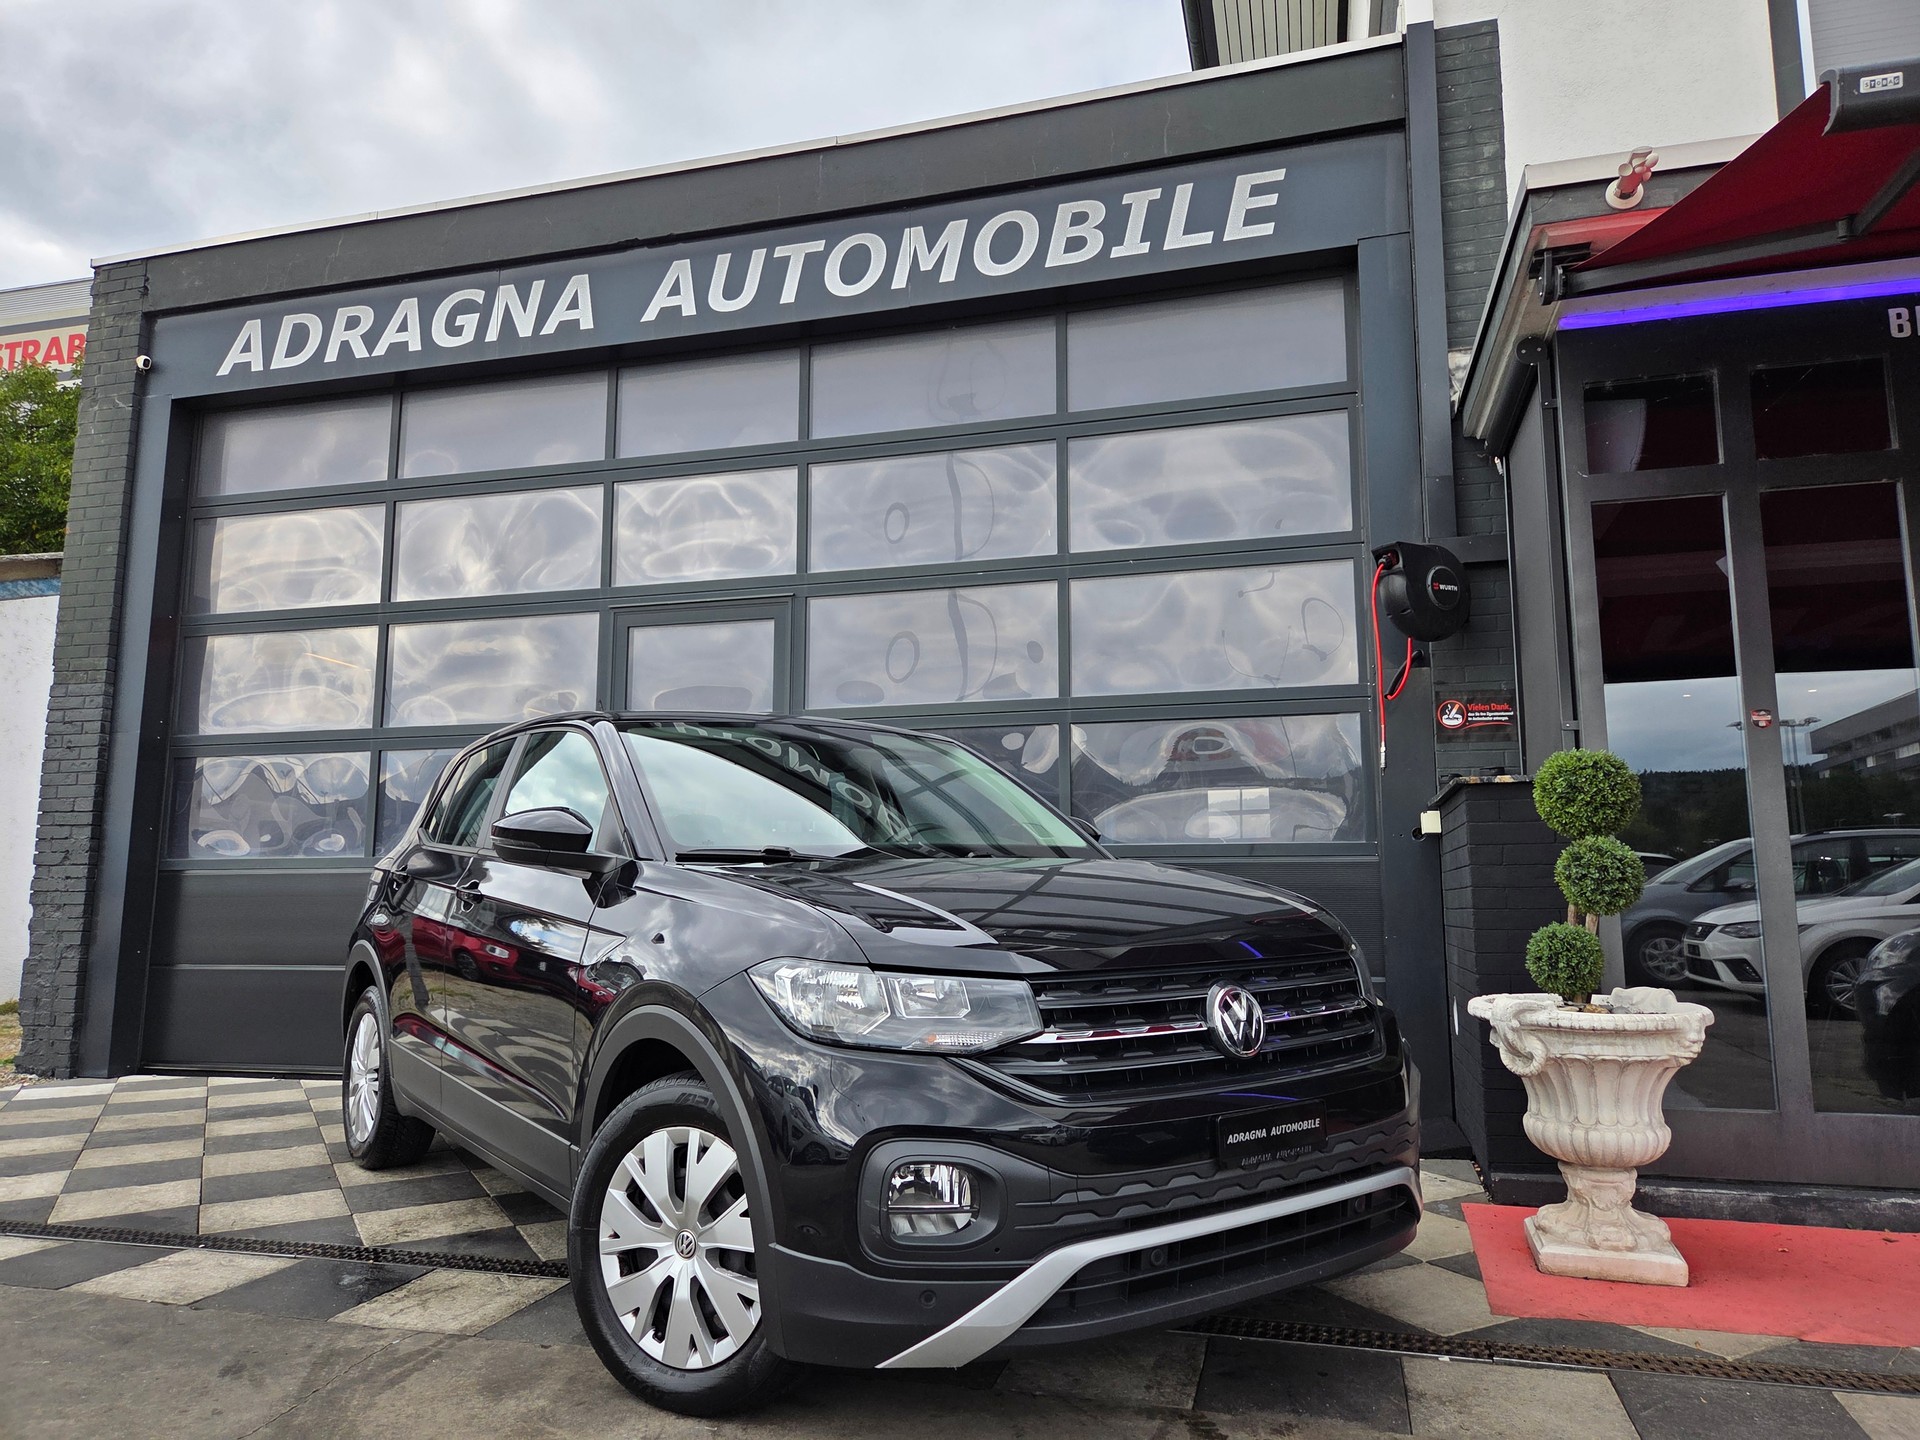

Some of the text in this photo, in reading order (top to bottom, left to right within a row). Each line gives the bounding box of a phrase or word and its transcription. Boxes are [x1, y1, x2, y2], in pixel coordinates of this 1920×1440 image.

[216, 168, 1286, 376] ADRAGNA AUTOMOBILE
[0, 333, 86, 373] TRAB
[1467, 703, 1490, 711] Vielen
[1227, 1118, 1321, 1145] ADRAGNA AUTOMOBILE
